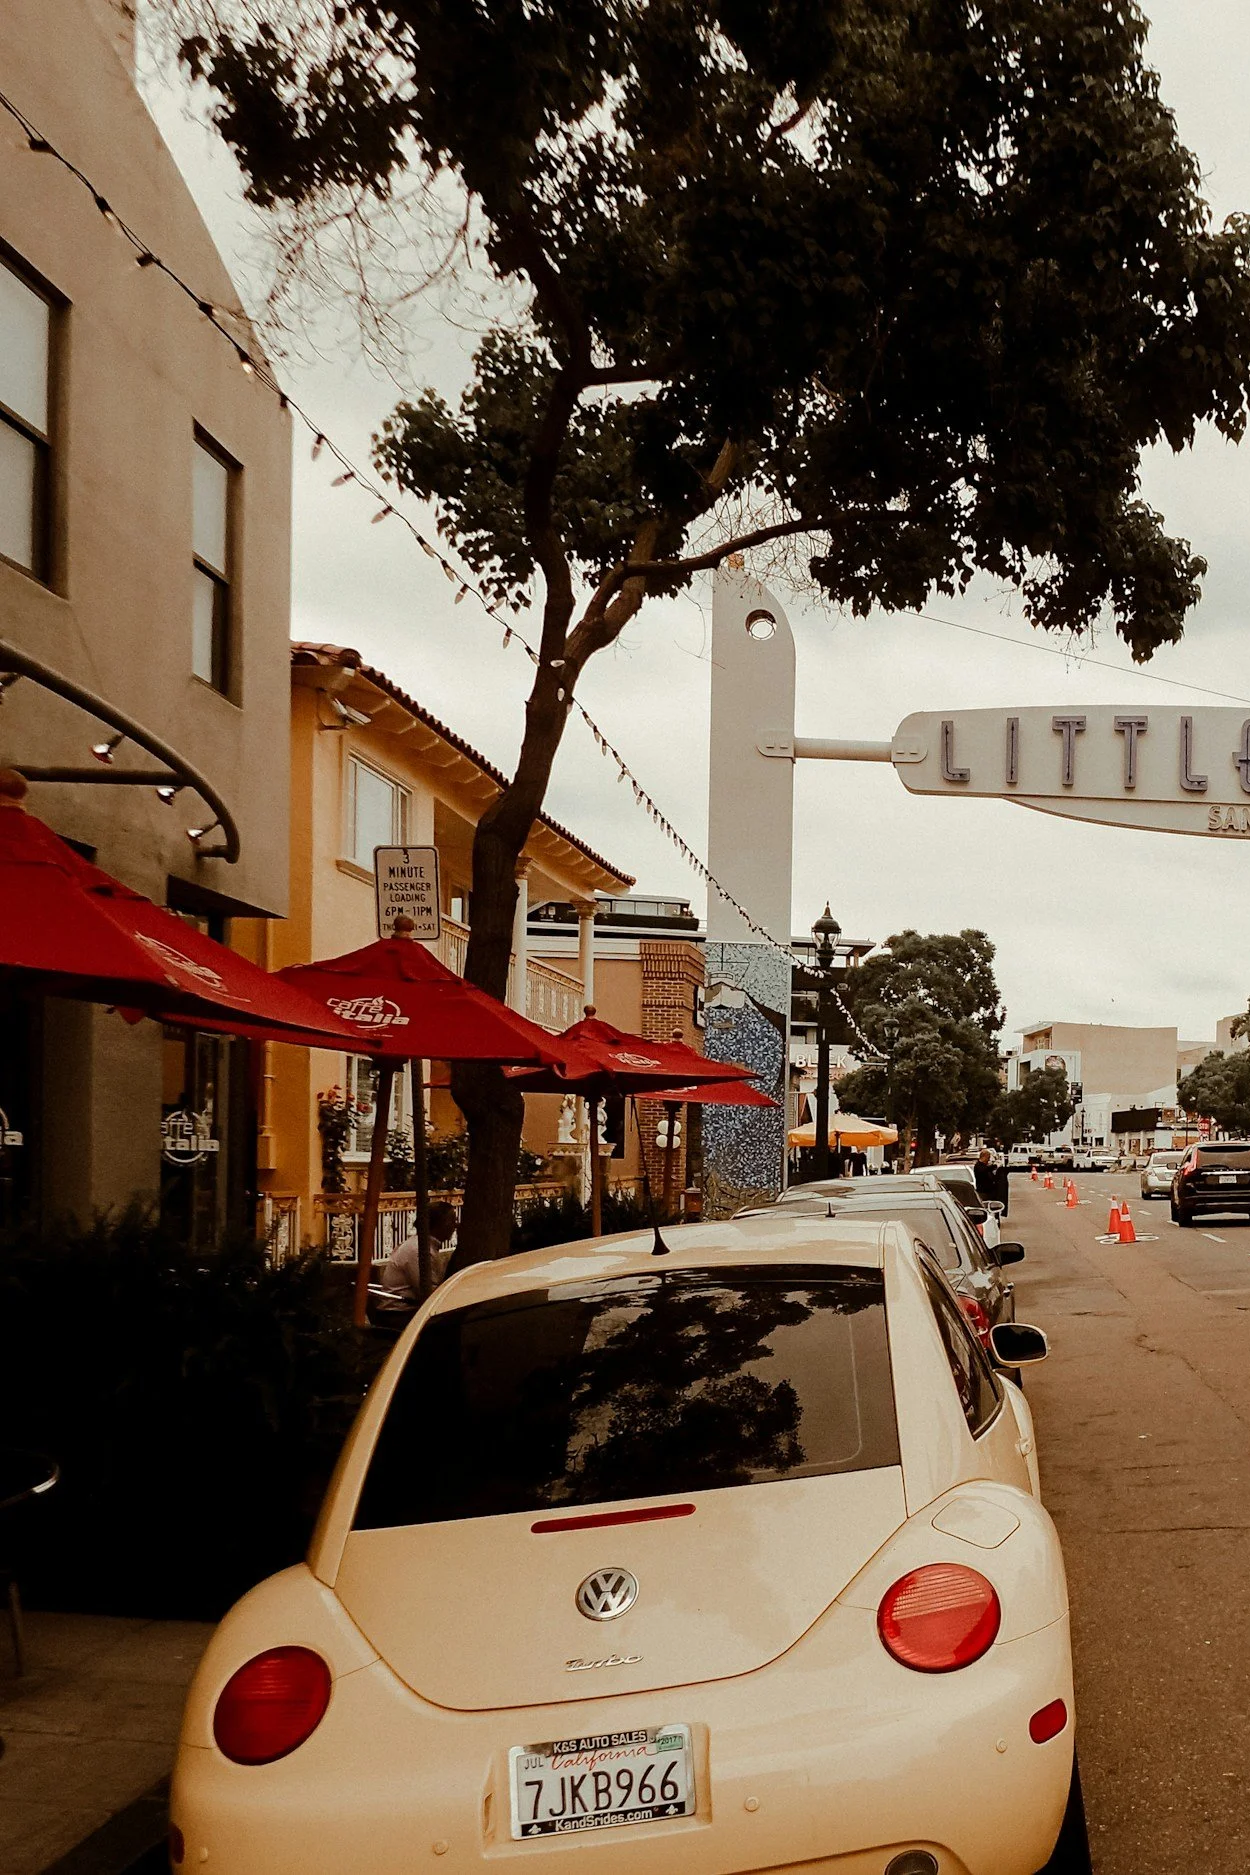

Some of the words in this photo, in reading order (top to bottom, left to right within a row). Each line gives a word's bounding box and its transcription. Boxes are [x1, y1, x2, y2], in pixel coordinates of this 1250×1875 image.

[402, 852, 410, 864] 3
[388, 866, 425, 878] MINUTE
[383, 882, 432, 891] PASSENGER
[389, 893, 426, 903] LOADING
[565, 1654, 644, 1673] Turbo
[553, 1738, 578, 1754] K&S
[578, 1735, 610, 1751] AUTO
[611, 1730, 648, 1747] SALES
[660, 1735, 678, 1745] 2017
[524, 1757, 544, 1770] JUL
[551, 1745, 655, 1771] California
[524, 1760, 680, 1820] 7JKB966
[555, 1808, 653, 1832] KandSrides.com
